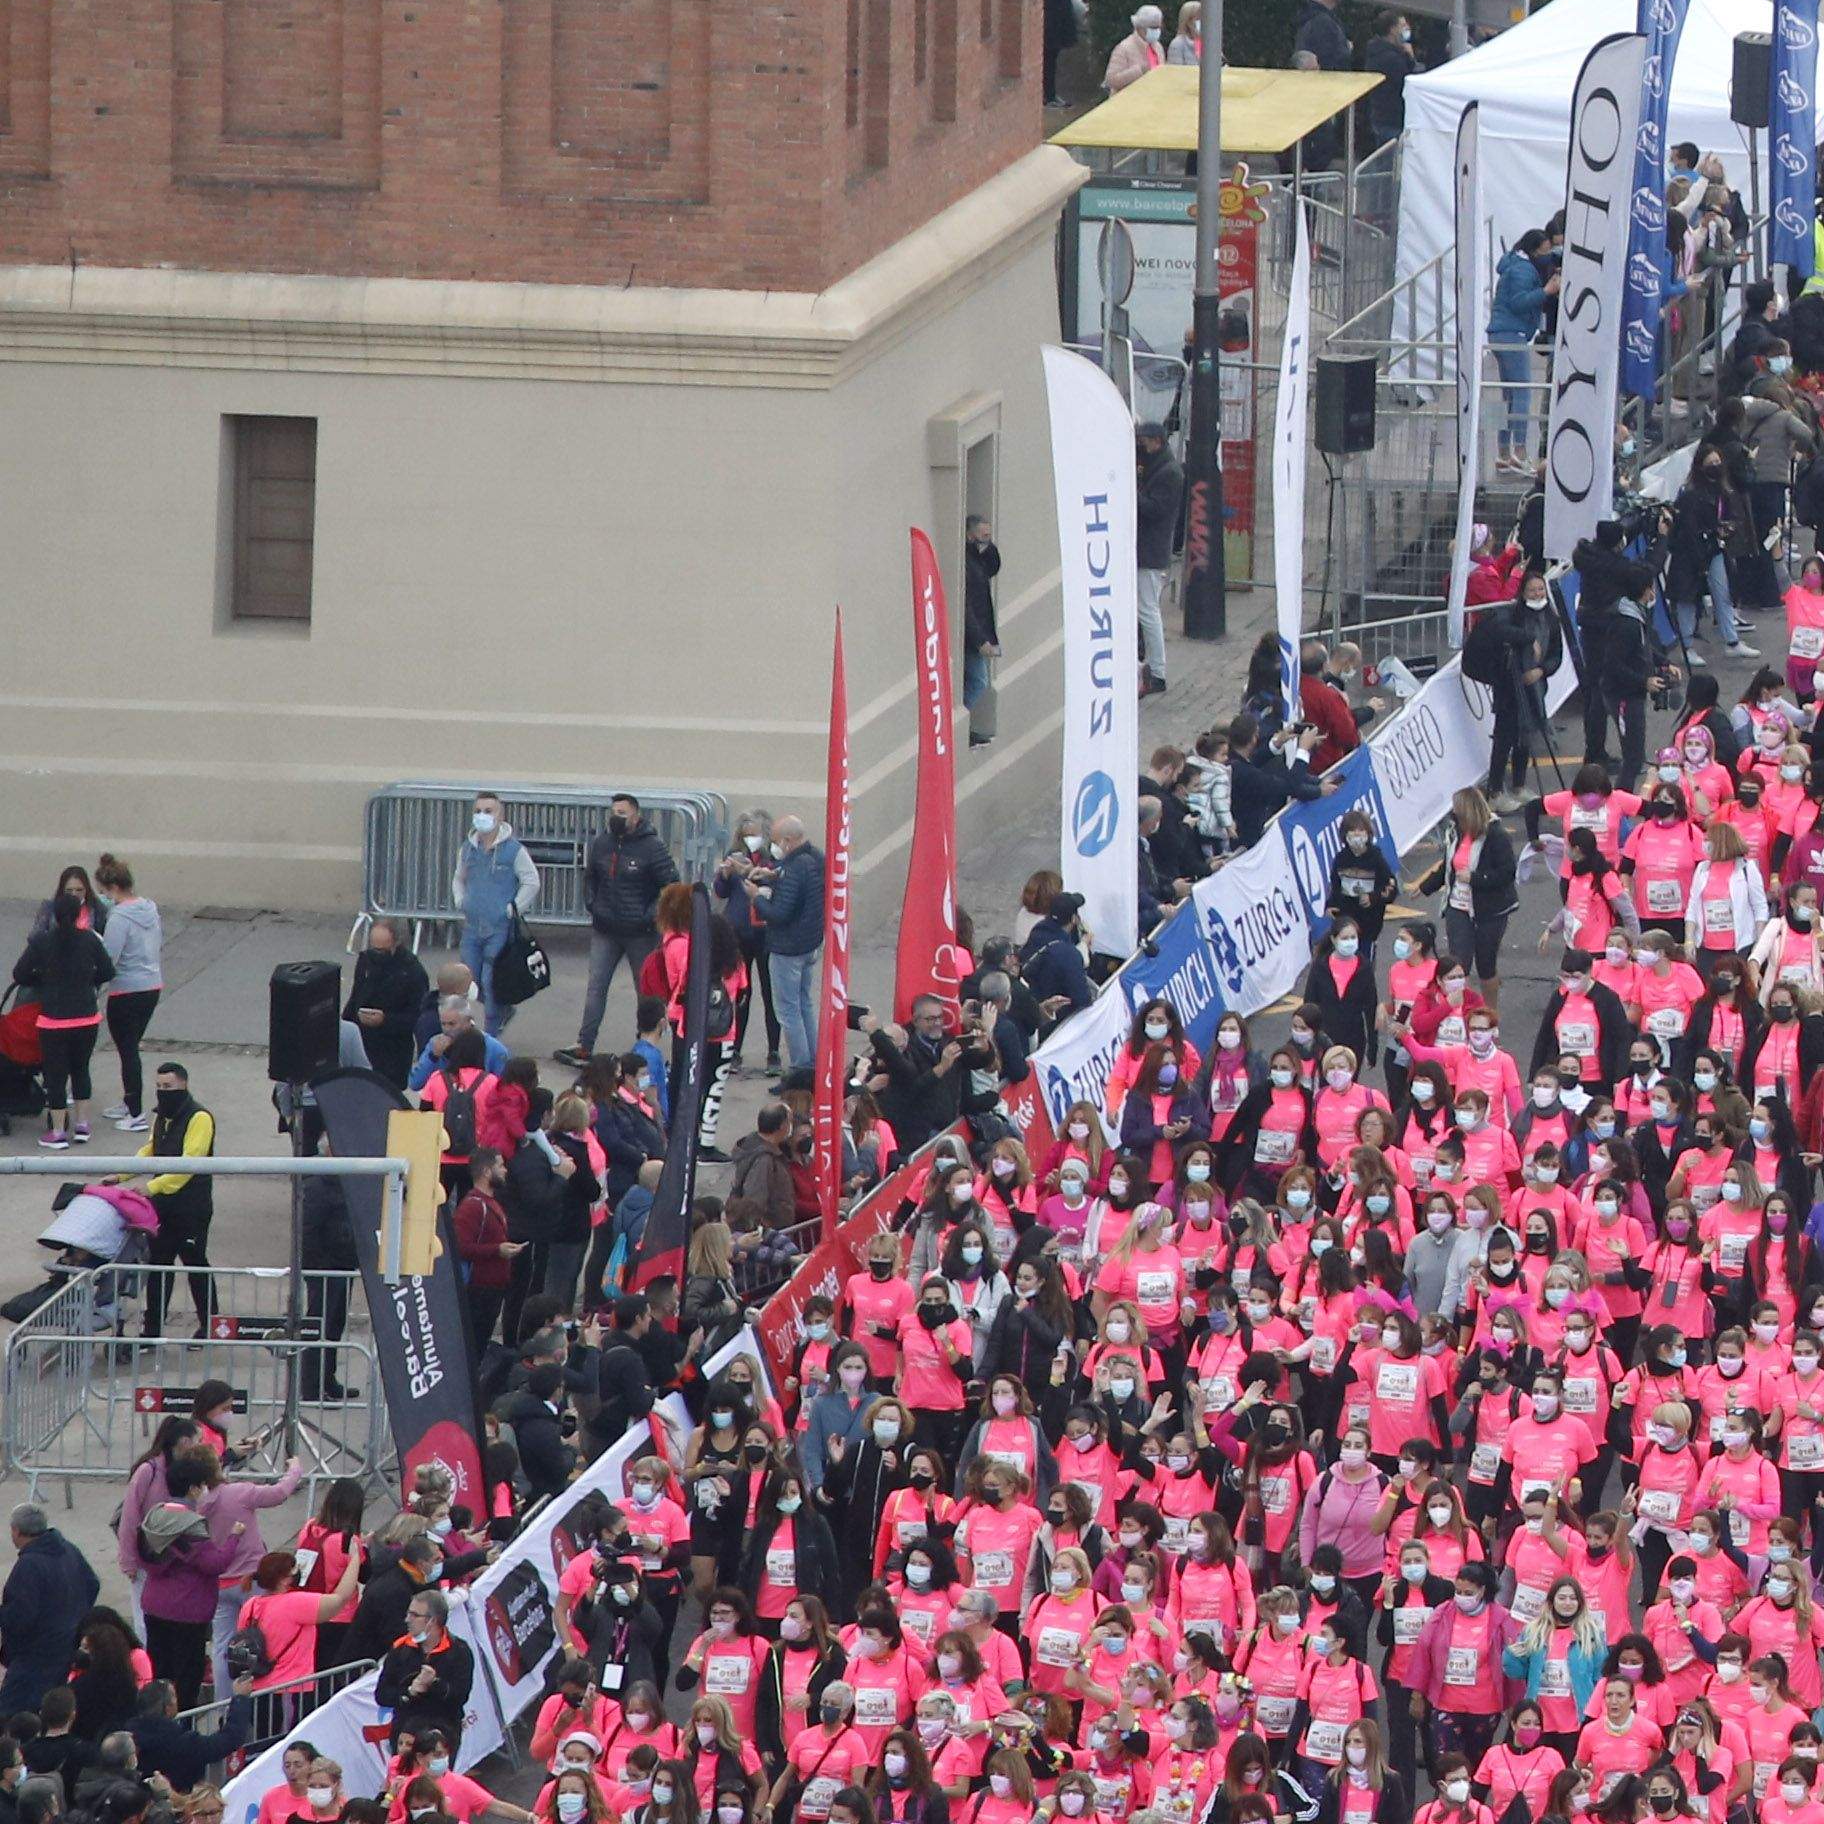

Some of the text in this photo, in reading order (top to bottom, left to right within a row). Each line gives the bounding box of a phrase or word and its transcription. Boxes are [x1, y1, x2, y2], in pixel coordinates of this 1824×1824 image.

[1164, 256, 1200, 270] nov
[1550, 87, 1621, 504] OYSHO
[1234, 886, 1300, 966] ZURICH
[1158, 949, 1216, 1027] URICH
